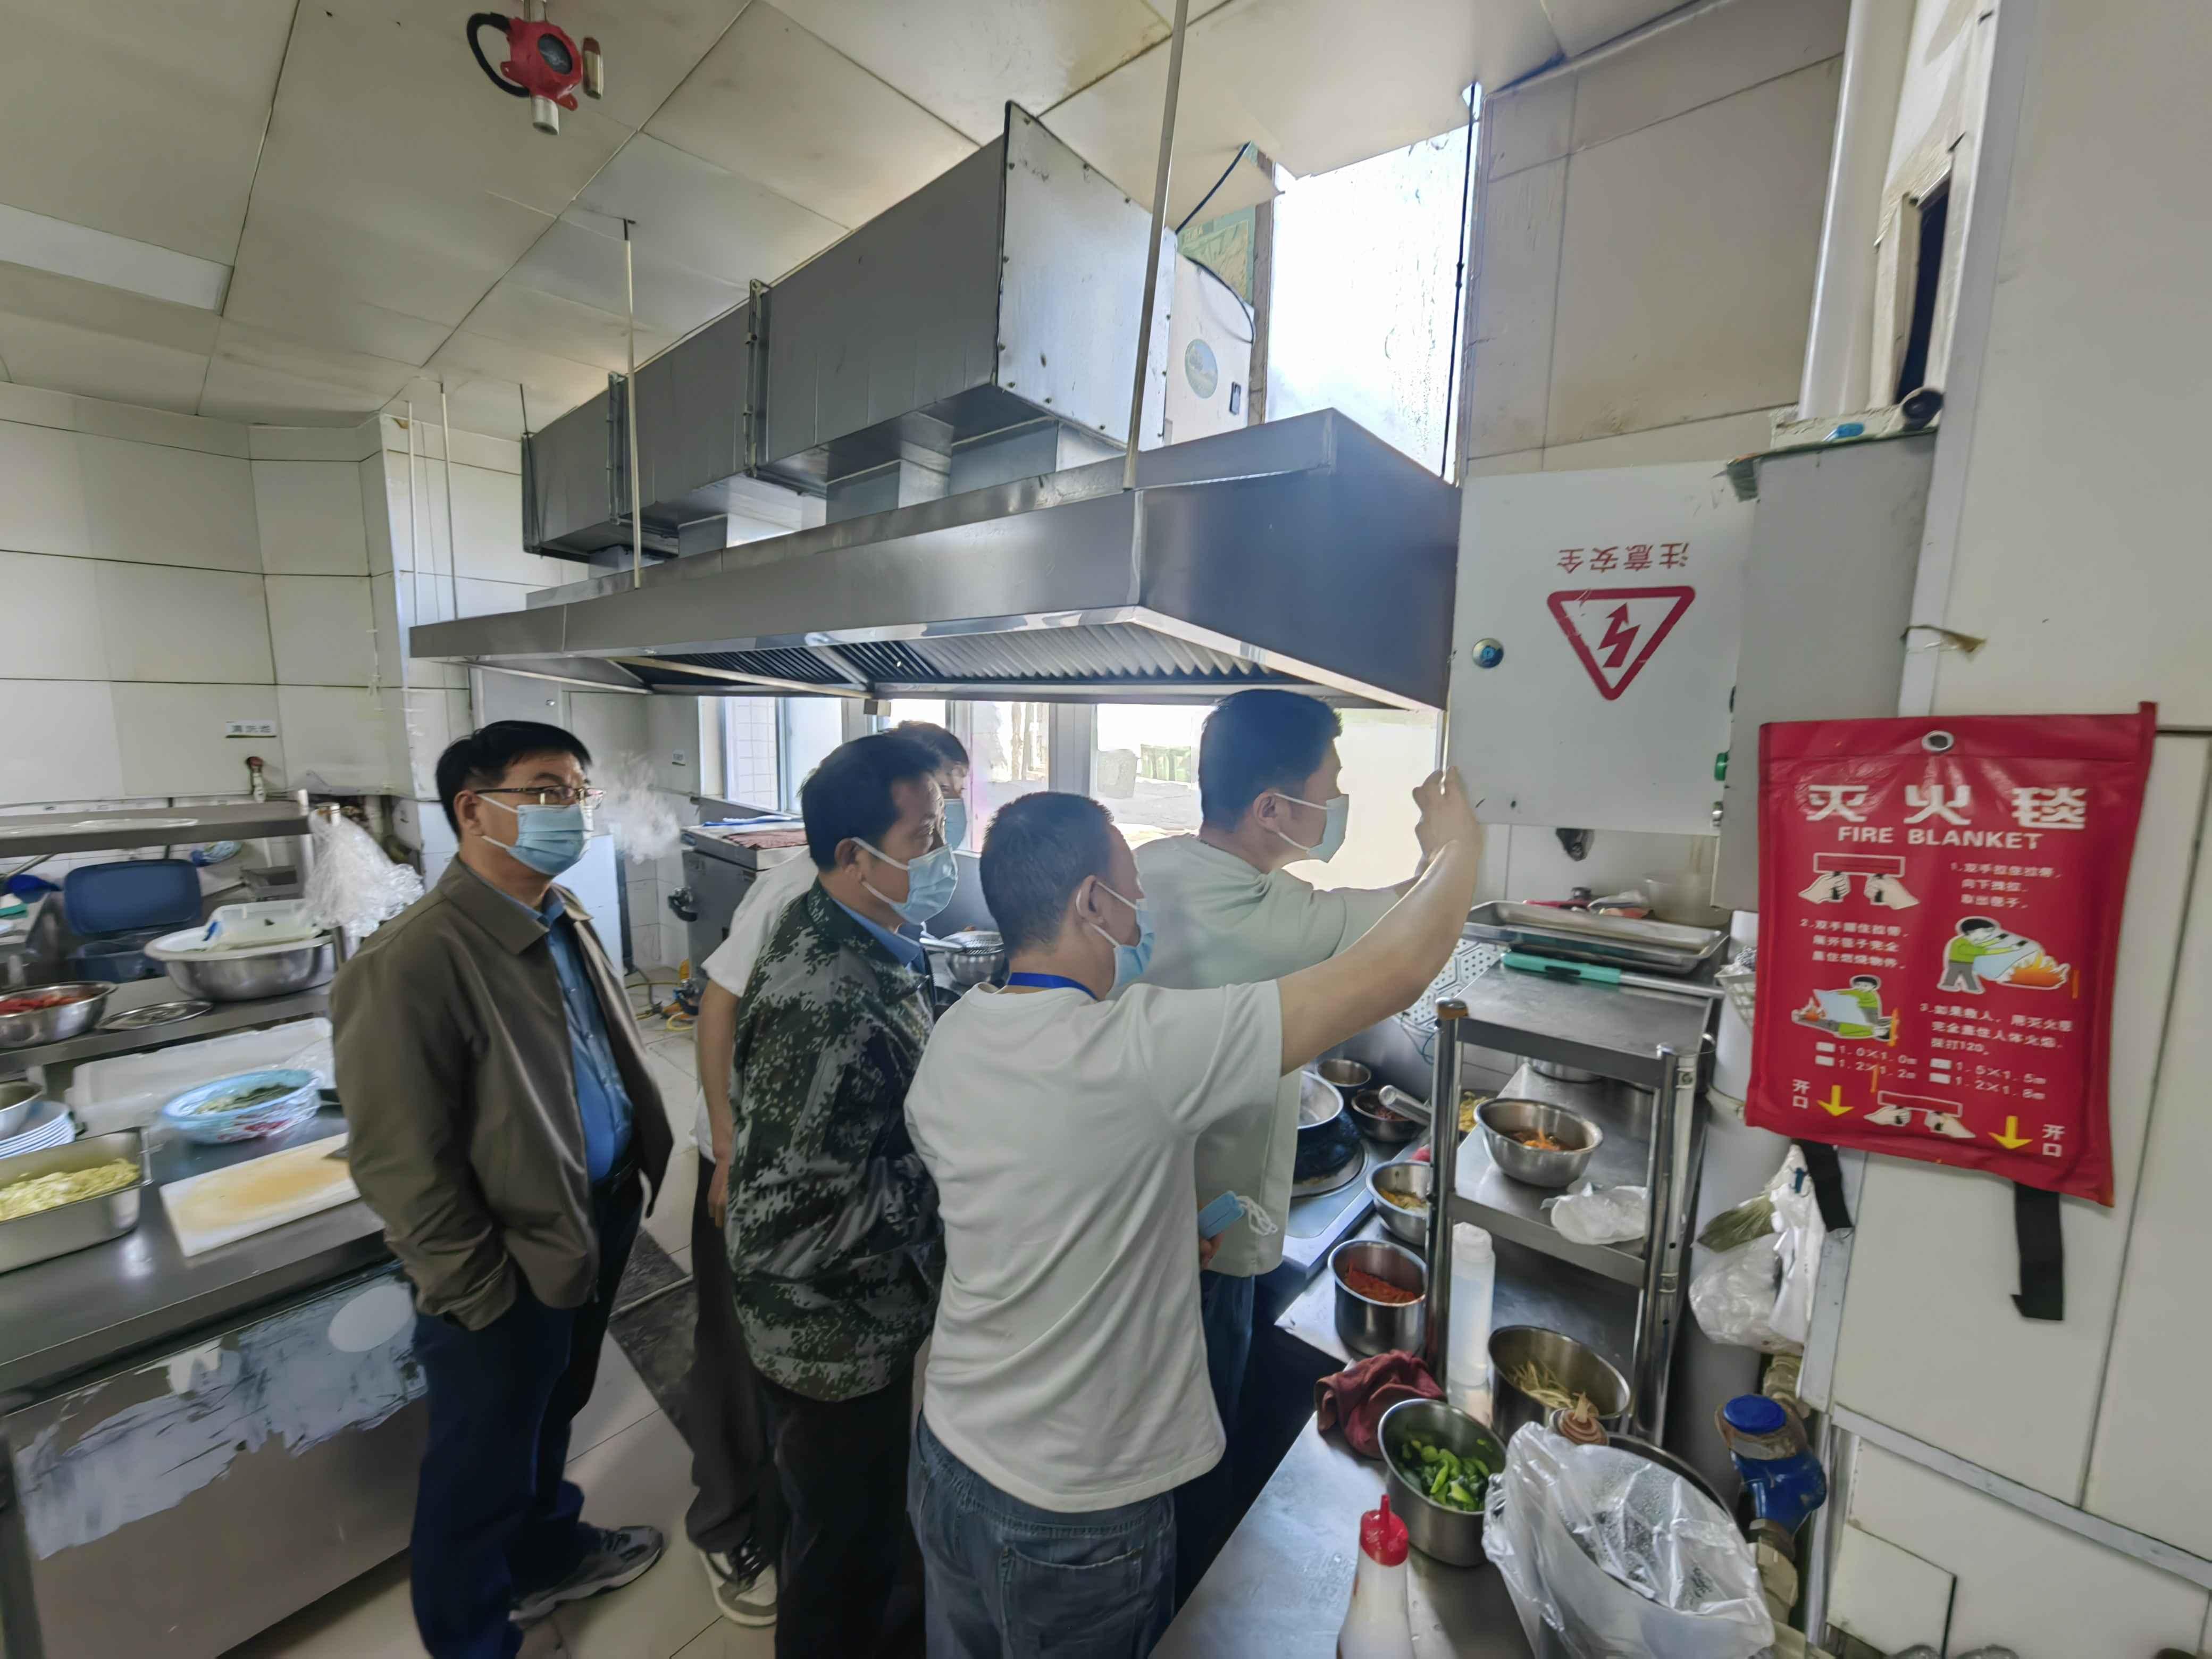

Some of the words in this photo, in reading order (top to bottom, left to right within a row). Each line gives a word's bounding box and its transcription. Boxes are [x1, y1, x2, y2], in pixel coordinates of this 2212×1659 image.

[1557, 542, 1689, 574] 注意安全
[1806, 784, 2087, 830] 灭火毯
[1838, 826, 1895, 843] FIRE
[1907, 828, 2043, 850] BLANKET
[1792, 1078, 1810, 1109] 开口
[2042, 1124, 2065, 1157] 开口
